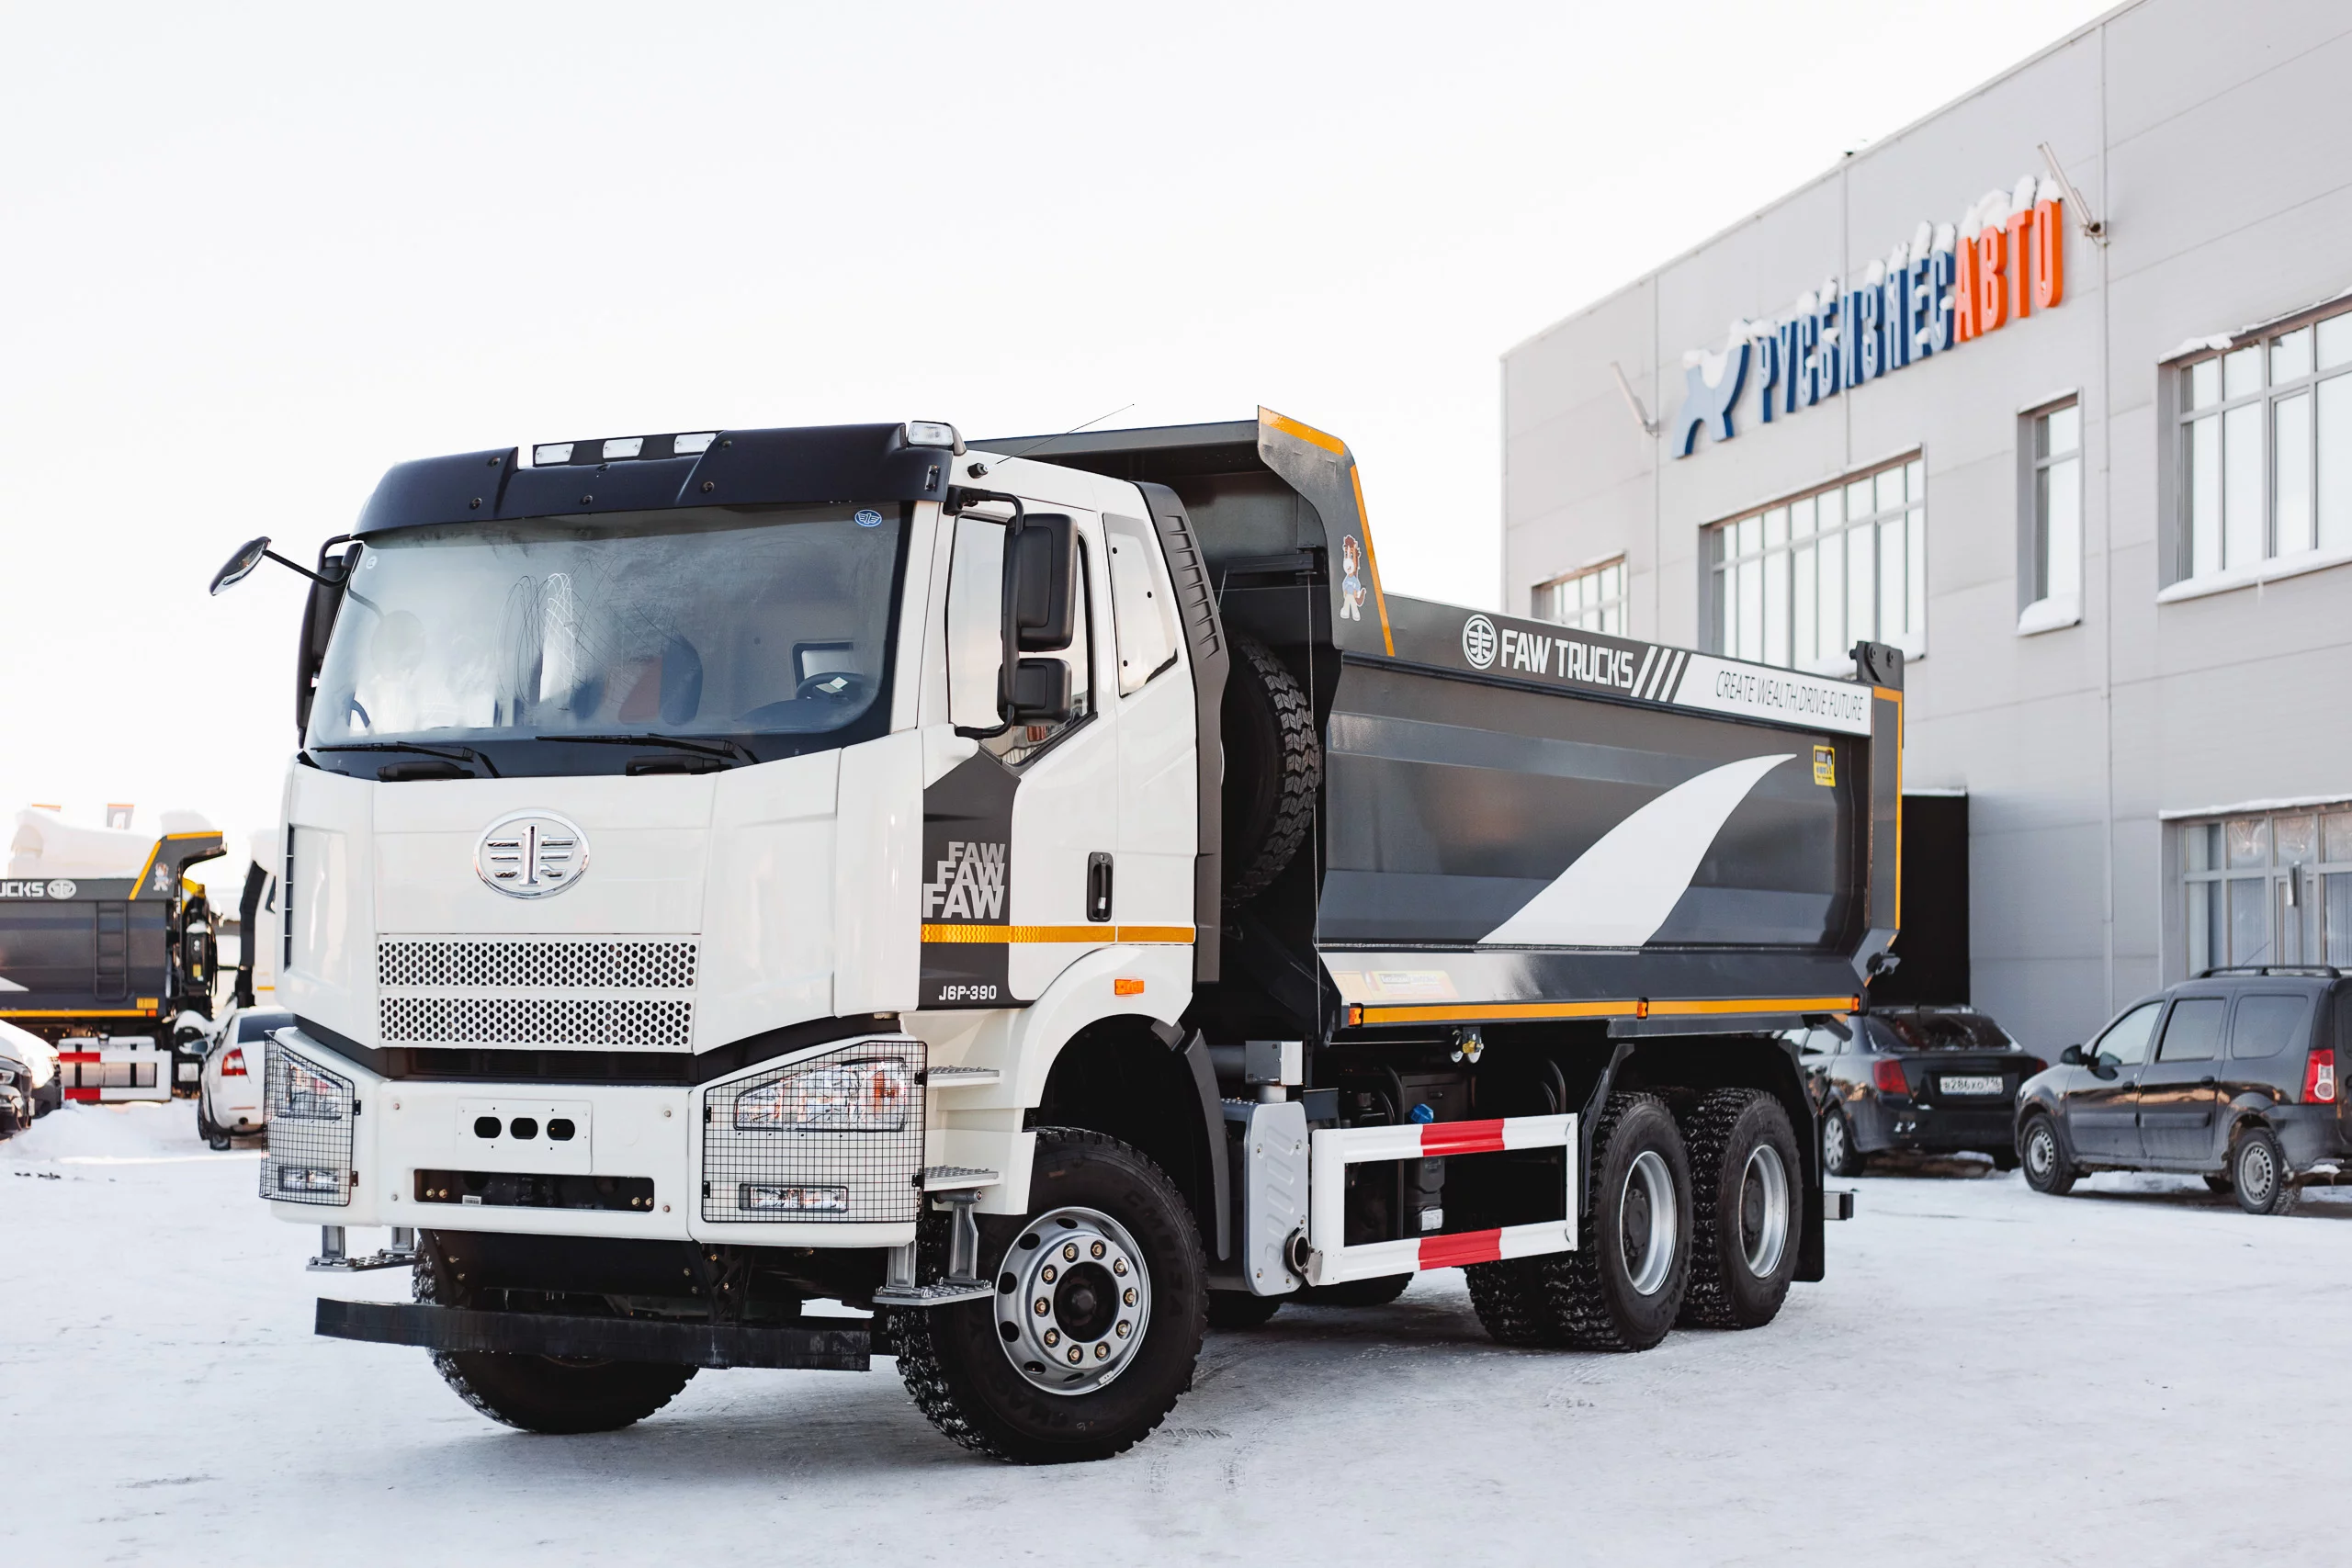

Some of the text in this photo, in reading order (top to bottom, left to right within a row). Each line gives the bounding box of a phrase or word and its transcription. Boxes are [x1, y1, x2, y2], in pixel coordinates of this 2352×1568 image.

[1501, 629, 1634, 689] FAW TRUCKS
[1716, 671, 1755, 702] CREATE
[1828, 692, 1863, 720] FUTURE
[948, 841, 1005, 867] FAW
[937, 861, 1004, 891] FAW
[922, 884, 1004, 919] FAW
[939, 986, 997, 1000] J6P-390
